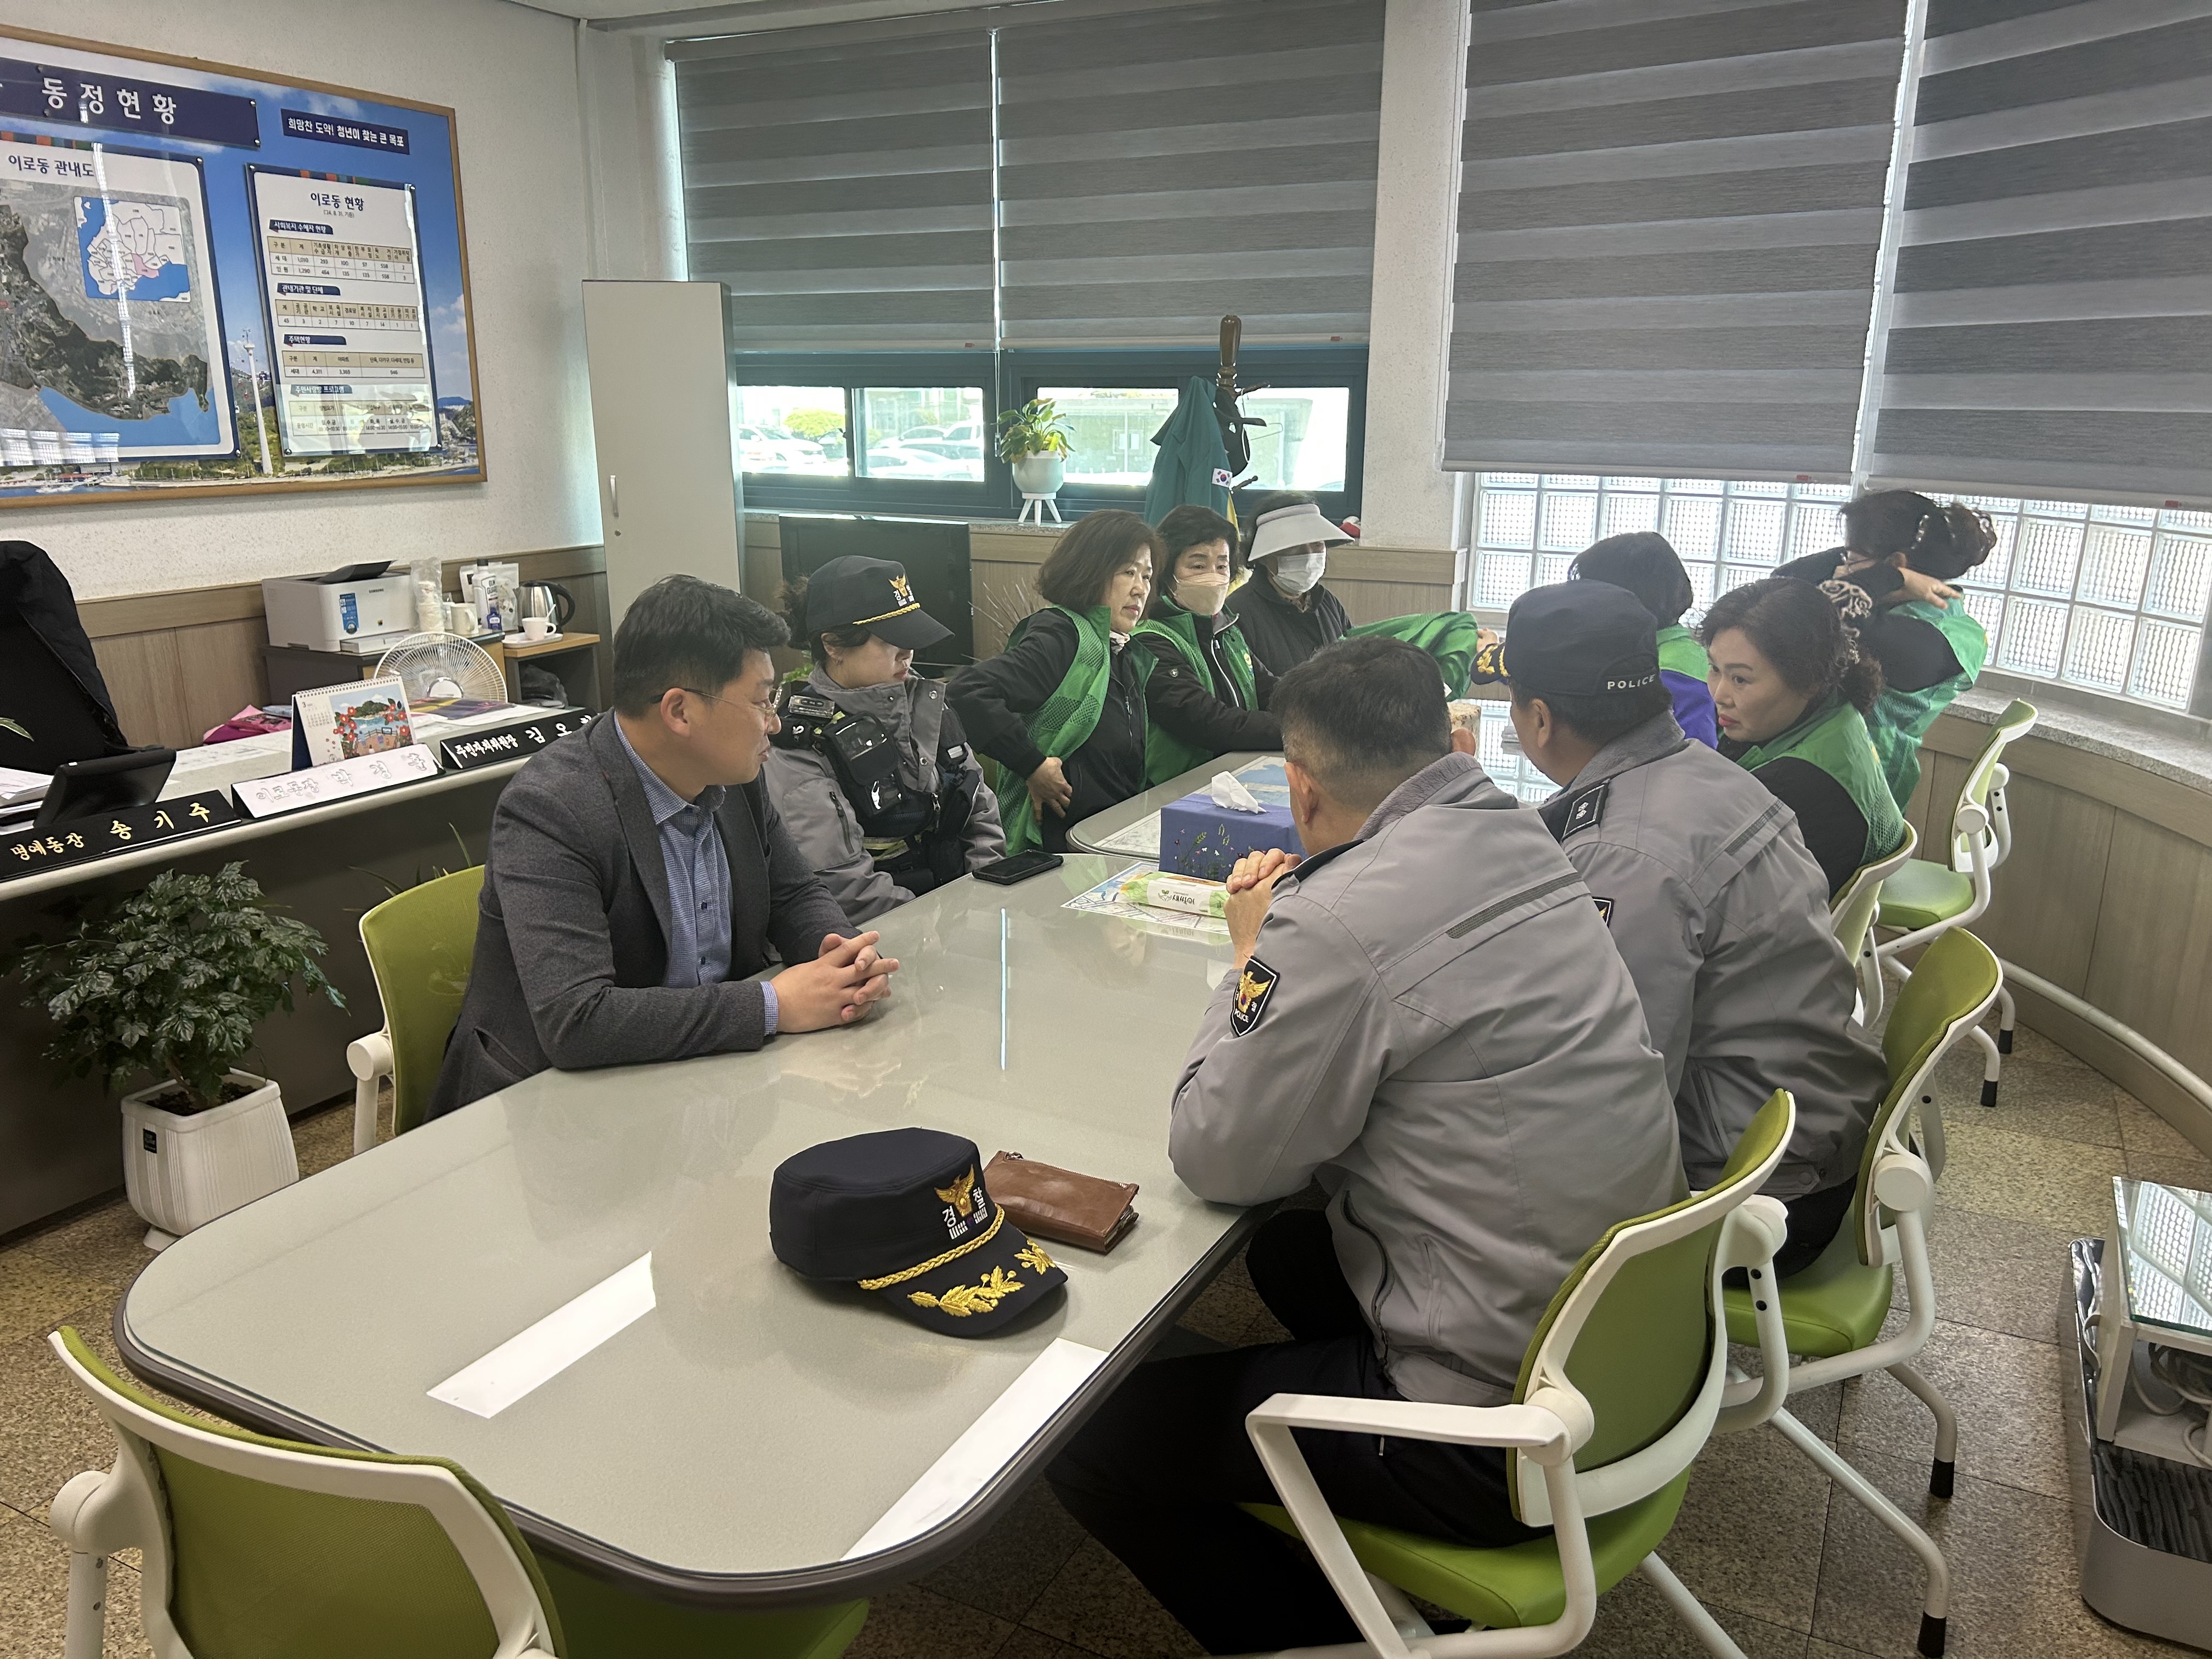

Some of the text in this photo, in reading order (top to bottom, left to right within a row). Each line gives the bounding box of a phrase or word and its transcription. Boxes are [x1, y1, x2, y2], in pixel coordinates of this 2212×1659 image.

[287, 117, 404, 147] 희망찬 도약! 청년이 찾는 큰 목포
[8, 155, 95, 178] 이로동 관내도
[311, 193, 364, 211] 이로동 현황
[274, 221, 326, 234] 사회복지 수혜자 현황
[282, 284, 324, 295] 관내기관 및 단체
[289, 335, 311, 344] 주택현황
[295, 385, 322, 394] 주민사랑방
[893, 589, 902, 601] 경
[1607, 674, 1656, 690] POLICE
[454, 733, 519, 759] 주민자치위원장
[256, 777, 319, 803] 이로동장
[10, 832, 84, 861] 명예동장
[1234, 1007, 1249, 1023] POLICE
[942, 1186, 986, 1228] 경 찰
